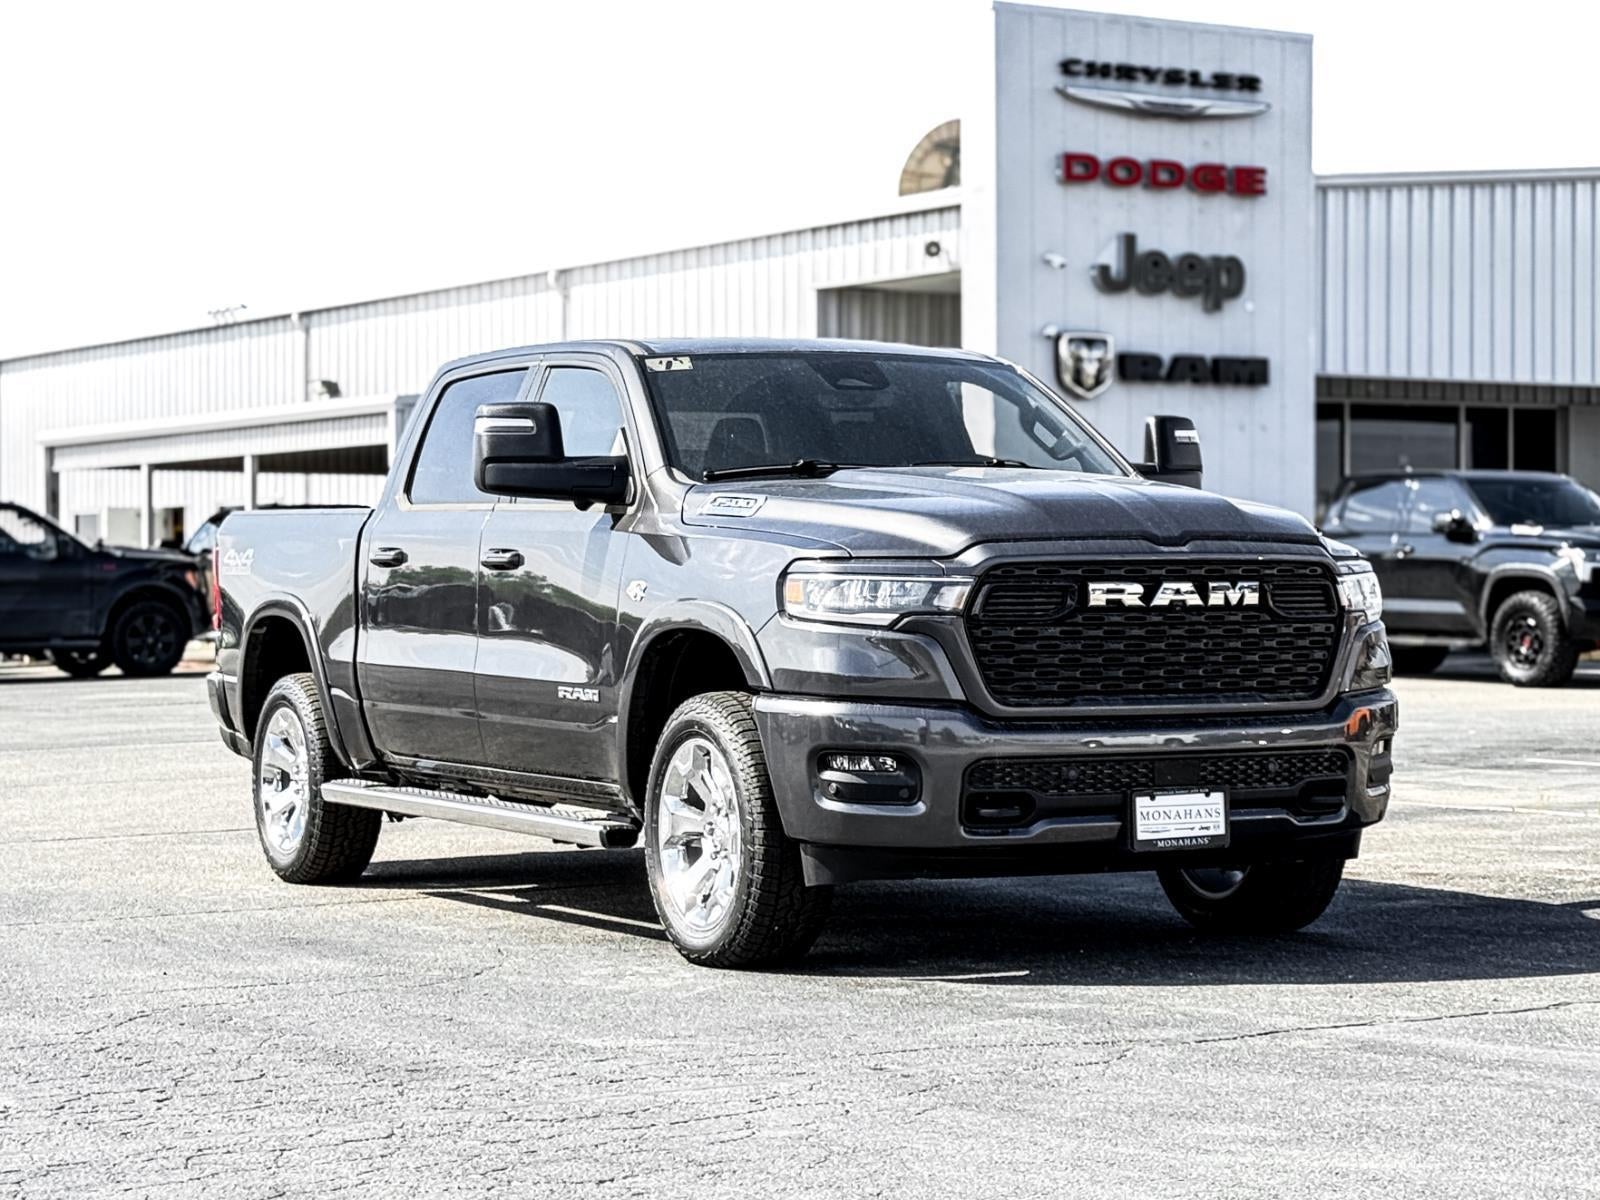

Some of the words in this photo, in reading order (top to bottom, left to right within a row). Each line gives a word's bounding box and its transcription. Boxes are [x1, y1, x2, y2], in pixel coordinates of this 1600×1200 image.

[1059, 58, 1262, 92] CHRYSLER
[1057, 152, 1267, 197] DODGE
[1092, 233, 1246, 313] Jeep
[1118, 353, 1269, 386] RAM
[1088, 581, 1260, 607] RAM
[557, 686, 600, 702] RAM
[1140, 808, 1221, 821] MONAHANS
